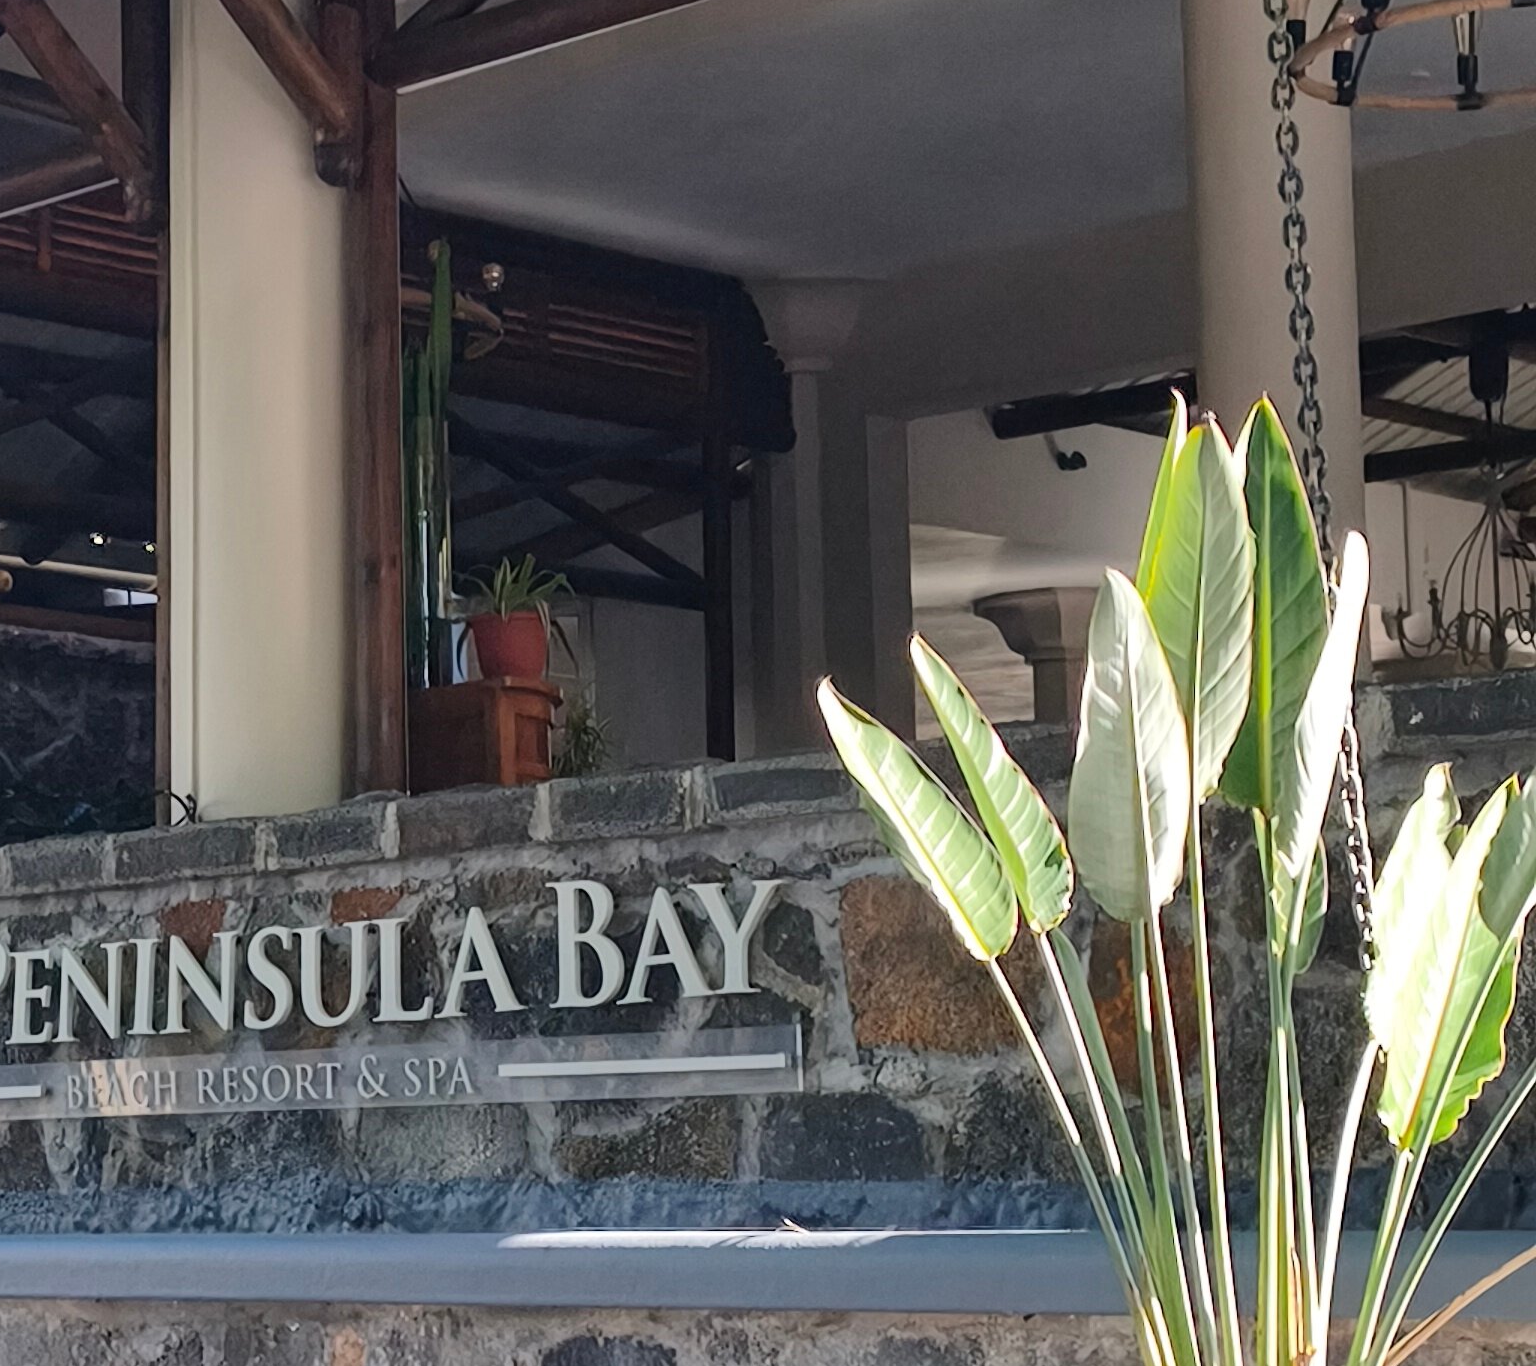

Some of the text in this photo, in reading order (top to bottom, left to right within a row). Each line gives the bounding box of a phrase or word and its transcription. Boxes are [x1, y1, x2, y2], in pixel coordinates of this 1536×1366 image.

[545, 879, 785, 1009] BAY
[67, 1054, 474, 1110] BEACH RESORT & SPA
